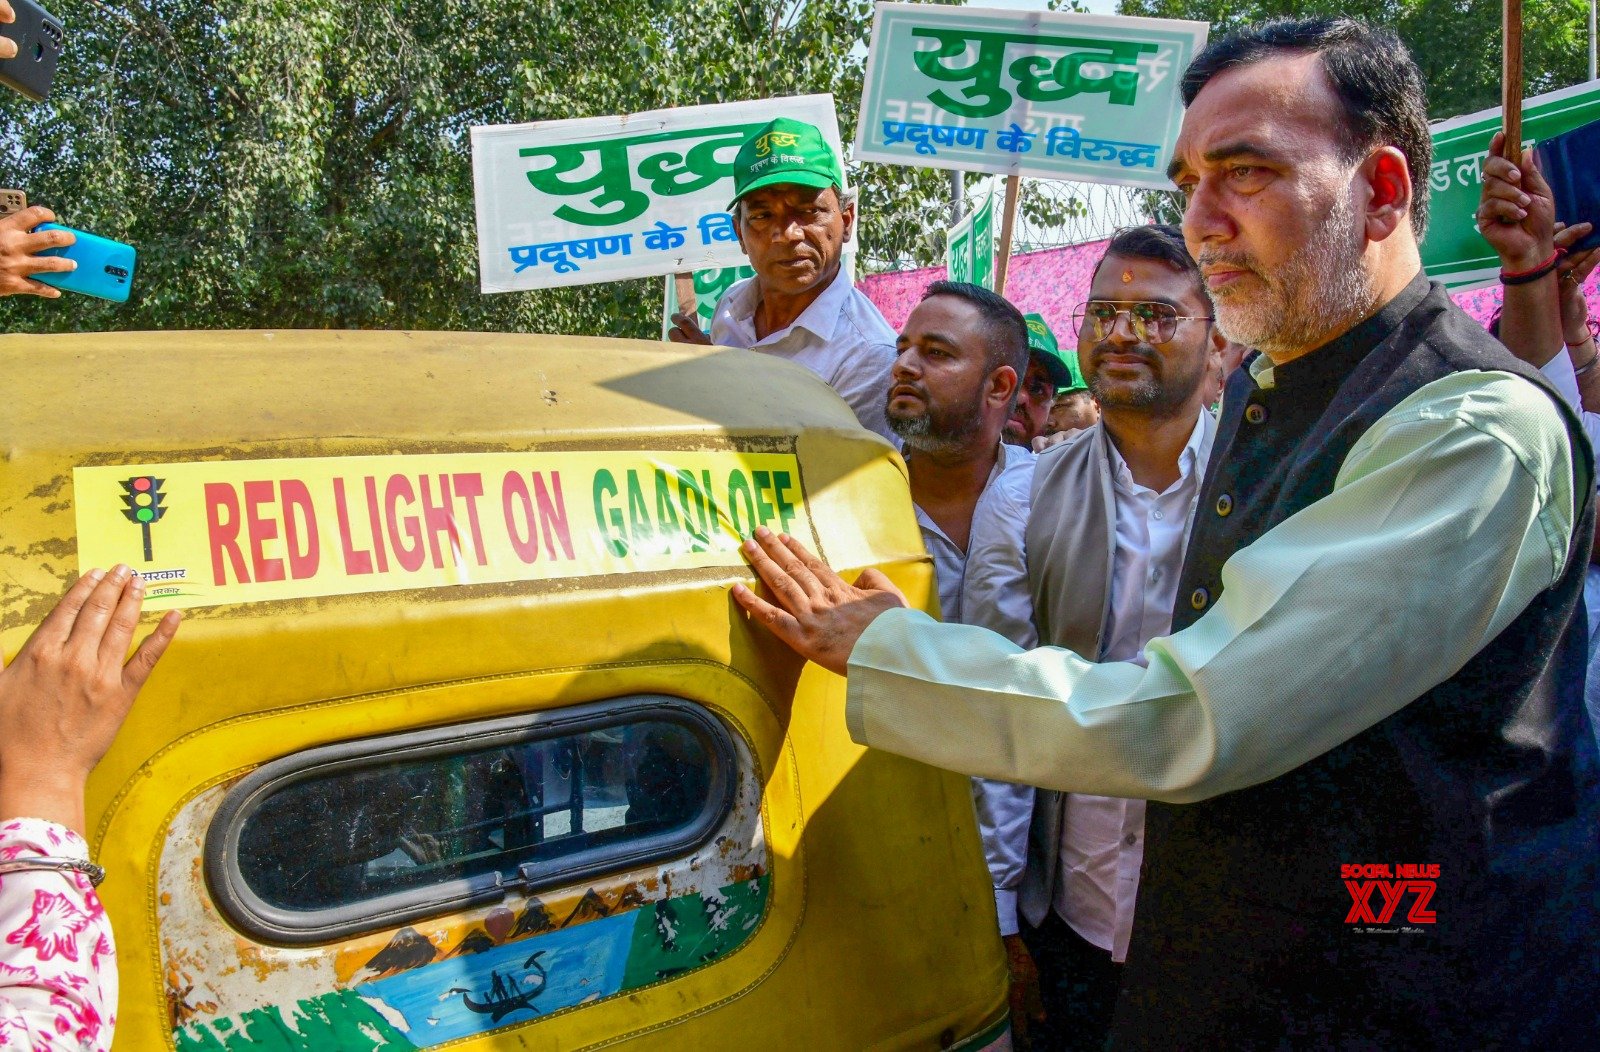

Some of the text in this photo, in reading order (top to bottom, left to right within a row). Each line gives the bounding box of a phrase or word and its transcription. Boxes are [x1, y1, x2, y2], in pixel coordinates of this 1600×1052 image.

[912, 27, 1159, 119] युद्ध
[755, 131, 801, 157] युद्ध
[882, 121, 989, 155] प्रदूषण
[996, 123, 1037, 153] के
[1045, 126, 1161, 168] विरुद्ध
[508, 233, 633, 273] प्रदूषण
[642, 220, 687, 251] के
[203, 468, 796, 587] RED LIGHT ON GAADI OFF
[140, 569, 187, 581] सरकार
